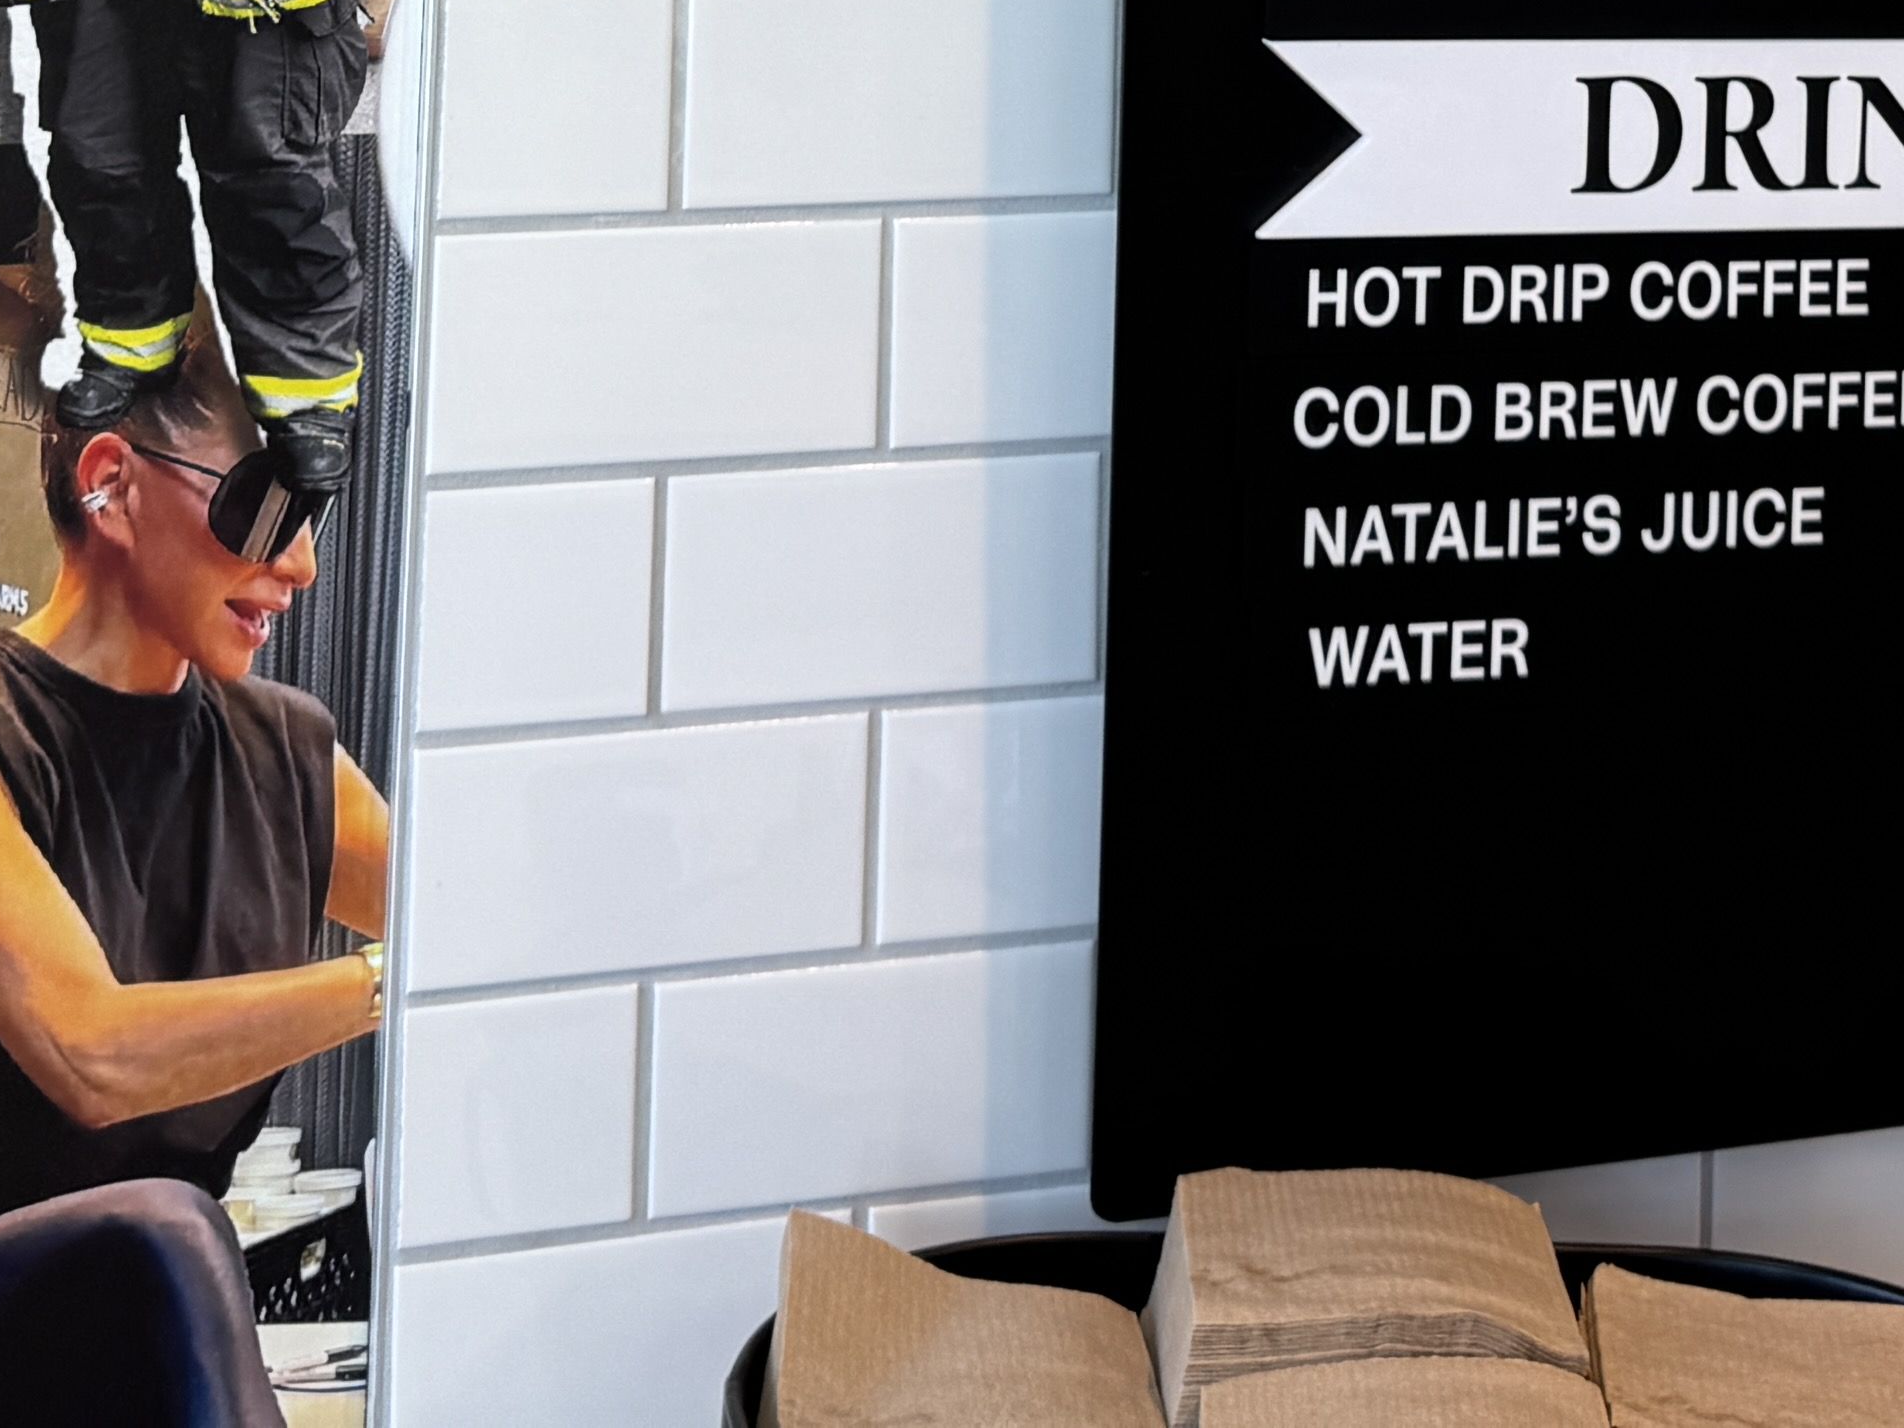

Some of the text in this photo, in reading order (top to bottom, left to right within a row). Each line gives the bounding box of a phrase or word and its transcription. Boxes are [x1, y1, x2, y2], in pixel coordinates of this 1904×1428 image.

[1307, 258, 1870, 328] HOT DRIP COFFEE
[1293, 384, 1472, 449] COLD
[1494, 377, 1678, 441] BREW
[1640, 486, 1825, 553] JUICE
[1308, 618, 1529, 687] WATER
